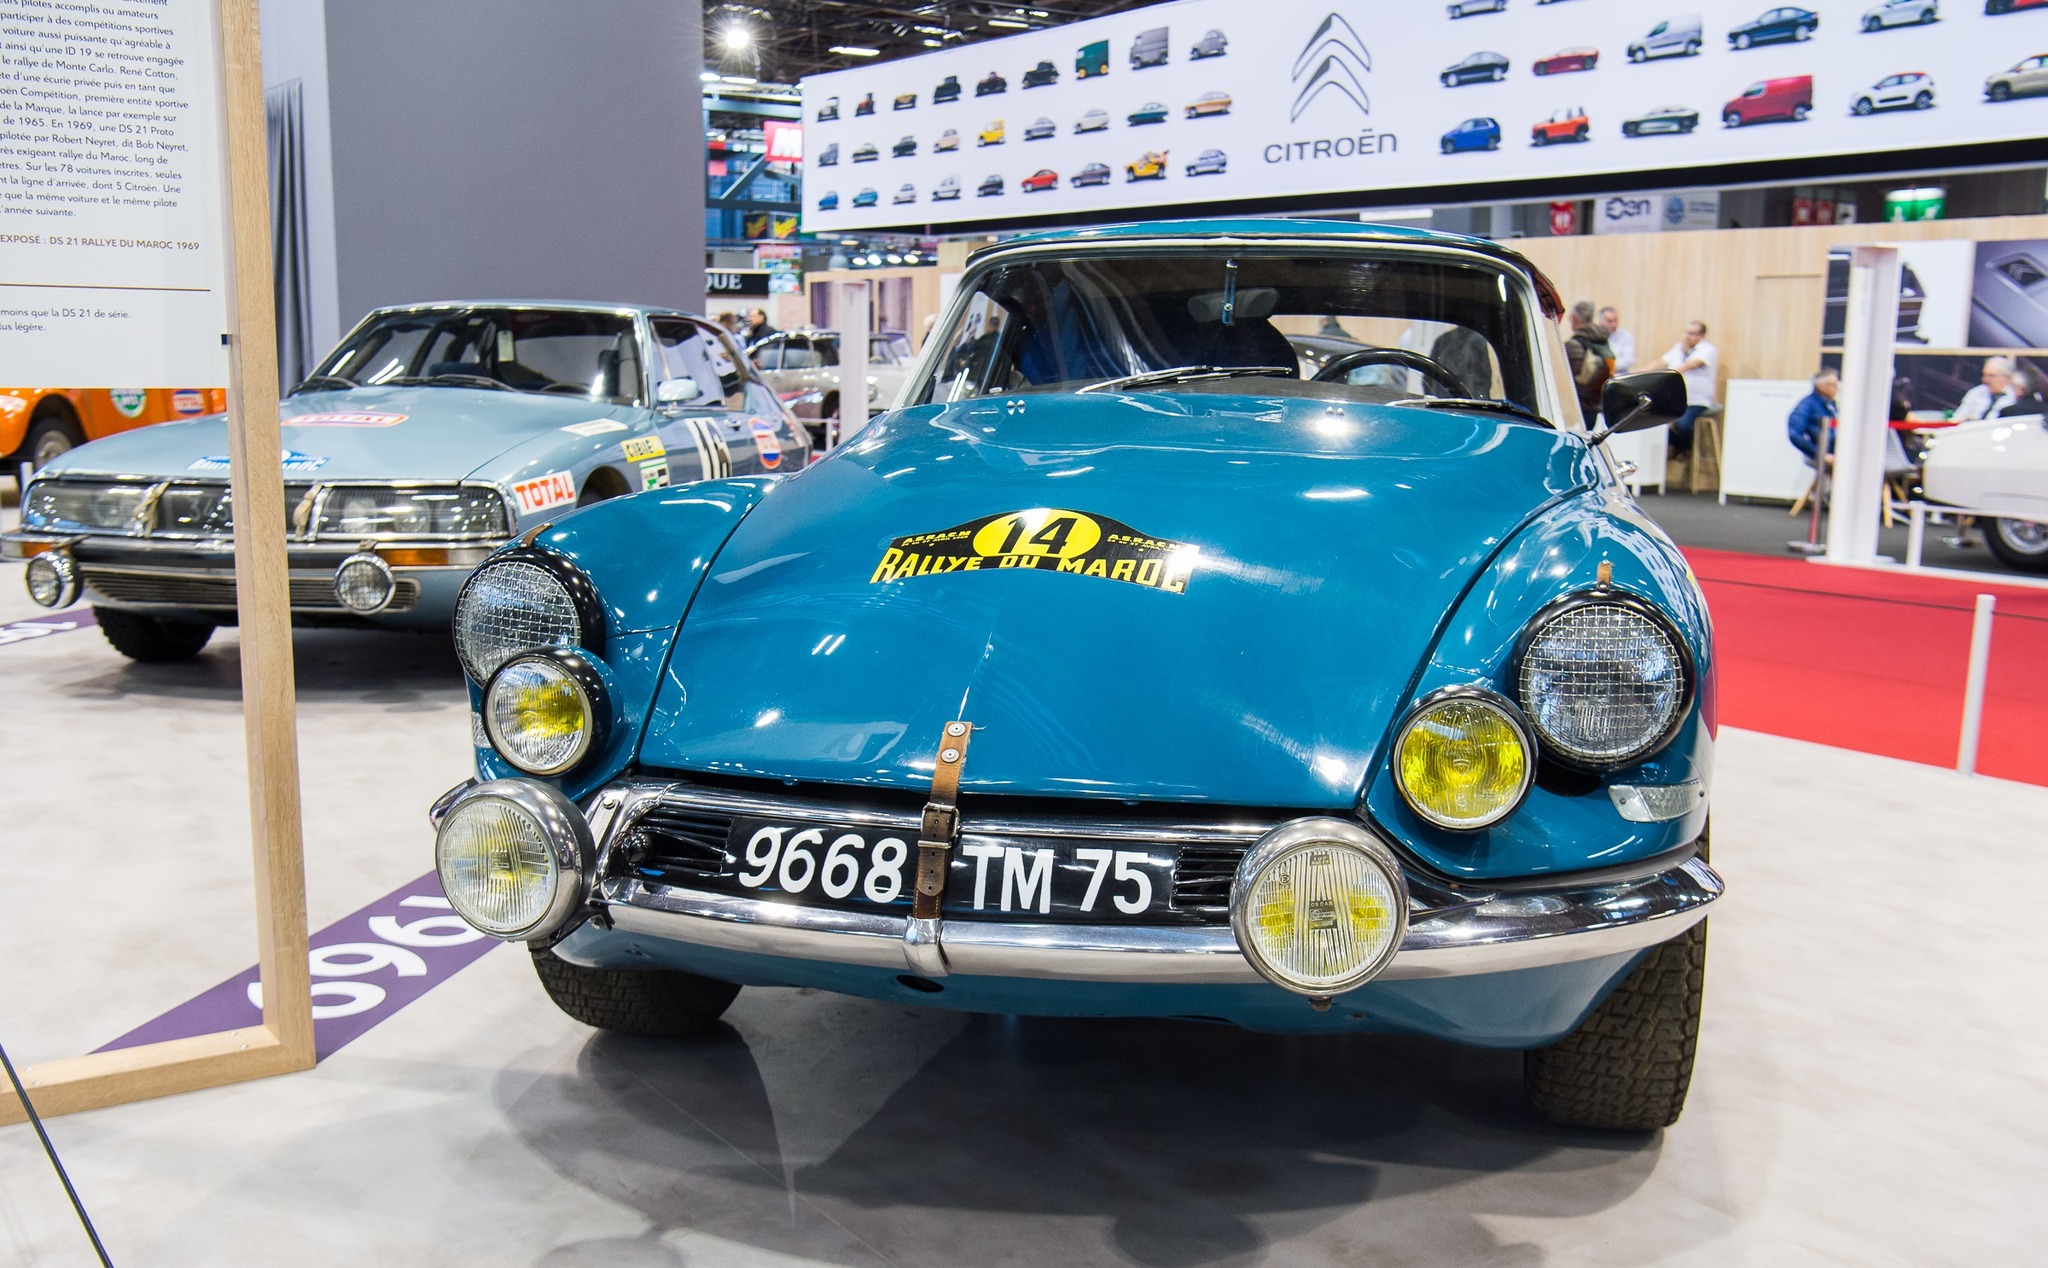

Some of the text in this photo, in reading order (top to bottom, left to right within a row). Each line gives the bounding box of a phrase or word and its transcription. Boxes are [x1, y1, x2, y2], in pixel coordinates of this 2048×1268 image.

[22, 0, 52, 8] pilotes
[55, 3, 100, 14] accomplis
[117, 9, 158, 19] amateurs
[0, 12, 173, 35] participer à des compétitions sportives
[3, 27, 35, 37] voiture
[64, 33, 107, 43] puissante
[110, 37, 163, 49] qu'agréable
[5, 42, 27, 51] ainsi
[30, 44, 63, 54] qu'une
[66, 47, 76, 55] ID
[80, 48, 92, 56] 19
[108, 52, 144, 62] retrouve
[146, 57, 184, 67] engagée
[2, 55, 178, 80] le rallye de Monte Carlo. René Cotton,
[14, 72, 41, 82] d'une
[44, 75, 71, 84] écurie
[74, 77, 101, 87] privée
[104, 81, 122, 89] puis
[159, 86, 176, 94] que
[21, 87, 81, 101] Compétition,
[85, 95, 124, 104] première
[127, 97, 152, 106] entité
[155, 100, 189, 108] sportive
[14, 101, 22, 110] la
[26, 102, 65, 115] Marque,
[68, 106, 76, 114] la
[80, 106, 103, 116] lance
[106, 111, 120, 119] par
[123, 112, 161, 122] exemple
[3, 116, 15, 125] de
[19, 117, 48, 127] 1965.
[52, 119, 64, 128] En
[68, 121, 96, 132] 1969,
[119, 124, 132, 133] DS
[151, 127, 174, 136] Proto
[0, 131, 32, 141] pilotée
[52, 134, 82, 144] Robert
[86, 137, 118, 148] Neyret,
[122, 138, 133, 148] dit
[136, 140, 154, 149] Bob
[157, 141, 189, 152] Neyret,
[17, 148, 56, 158] exigeant
[60, 149, 83, 160] rallye
[86, 151, 98, 160] du
[101, 152, 131, 163] Maroc,
[135, 154, 154, 166] long
[157, 155, 168, 164] de
[26, 162, 42, 171] Sur
[45, 163, 58, 172] les
[61, 164, 74, 173] 78
[76, 166, 111, 175] voitures
[114, 168, 152, 178] inscrites,
[155, 170, 182, 179] seules
[10, 175, 18, 184] la
[21, 176, 44, 188] ligne
[47, 178, 89, 189] d'arrivée,
[92, 180, 113, 189] dont
[117, 182, 122, 190] 5
[125, 182, 160, 192] Citroën.
[163, 184, 181, 193] Une
[25, 191, 33, 200] la
[37, 193, 65, 201] même
[68, 195, 98, 203] voiture
[113, 196, 120, 204] le
[123, 198, 150, 206] même
[154, 198, 177, 208] pilote
[36, 208, 76, 216] suivante.
[0, 234, 40, 244] EXPOSÉ
[50, 236, 63, 245] DS
[67, 237, 78, 246] 21
[82, 237, 117, 247] RALLYE
[120, 239, 134, 248] DU
[137, 240, 173, 249] MAROC
[177, 241, 200, 250] 1969
[1, 308, 131, 318] moins que la DS 21 de série.
[15, 322, 46, 333] légère.
[514, 474, 574, 510] TOTAL
[998, 516, 1078, 554] 14
[870, 548, 1187, 593] RALLYE DU MAROC
[739, 826, 1152, 914] 9668 TM 75
